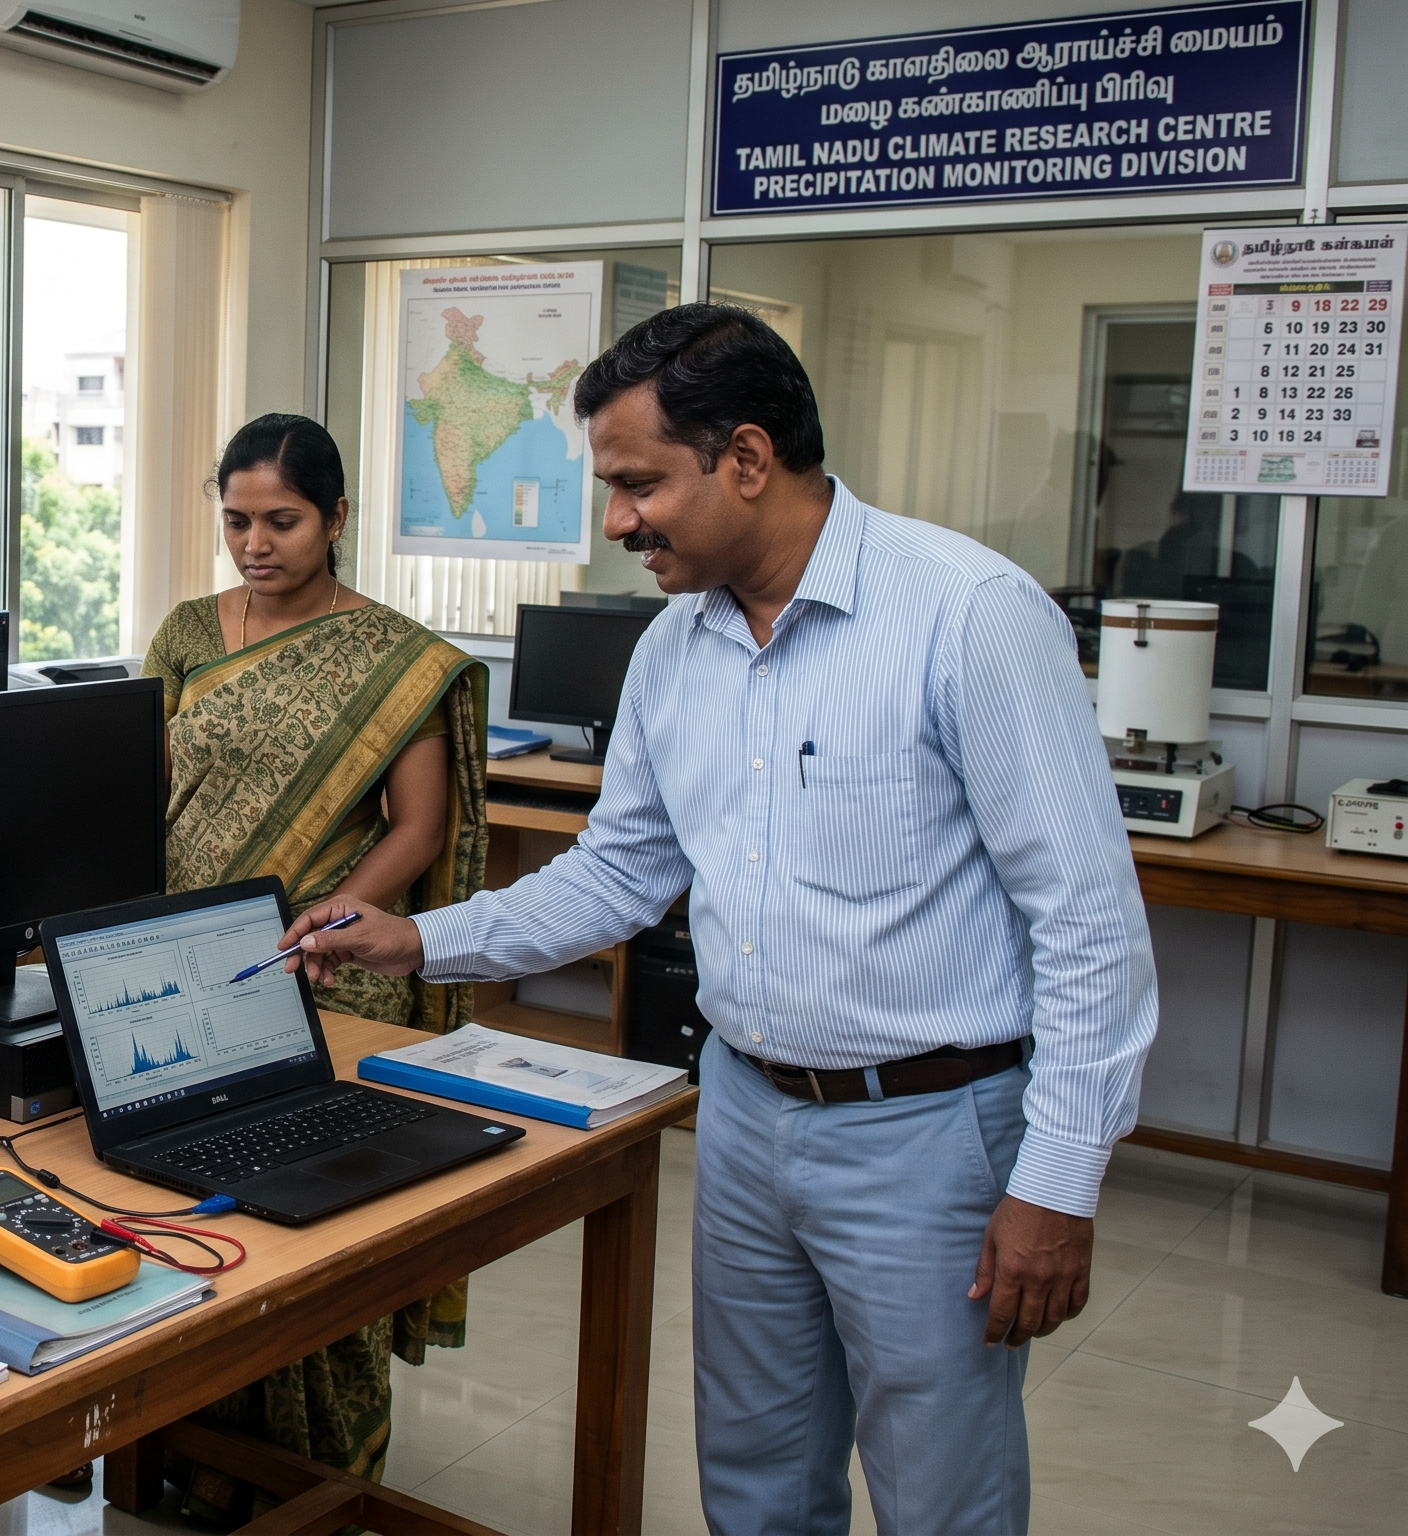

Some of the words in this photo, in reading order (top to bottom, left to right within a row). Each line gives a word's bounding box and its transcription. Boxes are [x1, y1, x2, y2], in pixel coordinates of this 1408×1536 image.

[732, 57, 860, 103] தமிழ்நாடு
[1015, 25, 1163, 73] ஆராய்ச்சி
[1169, 14, 1283, 53] மையம்
[820, 98, 893, 130] மழை
[898, 75, 1088, 119] கண்காணிப்பு
[1095, 69, 1175, 105] பிரிவு
[736, 144, 806, 171] TAMIL
[812, 138, 880, 166] NADU
[887, 129, 997, 160] CLIMATE
[1004, 118, 1149, 152] RESEARCH
[1157, 110, 1272, 142] CENTRE
[753, 165, 935, 199] PRECIPITATION
[943, 154, 1112, 188] MONITORING
[1120, 146, 1247, 178] DIVISION
[1291, 299, 1301, 313] 9
[1313, 299, 1332, 312] 18
[1340, 298, 1360, 312] 22
[1367, 298, 1388, 312] 29
[1285, 321, 1303, 335] 10
[1312, 321, 1330, 334] 19
[1338, 320, 1358, 334] 23
[1366, 320, 1386, 334] 30
[1262, 343, 1272, 356] 7
[1284, 343, 1299, 356] 11
[1309, 343, 1329, 356] 20
[1337, 342, 1357, 356] 24
[1364, 342, 1383, 356] 31
[1260, 365, 1270, 378] 8
[1282, 365, 1300, 378] 12
[1308, 365, 1325, 378] 21
[1335, 364, 1355, 378] 25
[1233, 386, 1240, 399] 1
[1258, 386, 1269, 399] 8
[1281, 386, 1298, 399] 13
[1306, 386, 1326, 399] 22
[1231, 407, 1241, 420] 2
[1257, 407, 1267, 420] 9
[1279, 408, 1296, 421] 14
[1305, 408, 1324, 421] 23
[1229, 429, 1239, 442] 3
[1252, 429, 1269, 442] 10
[1303, 430, 1322, 443] 24
